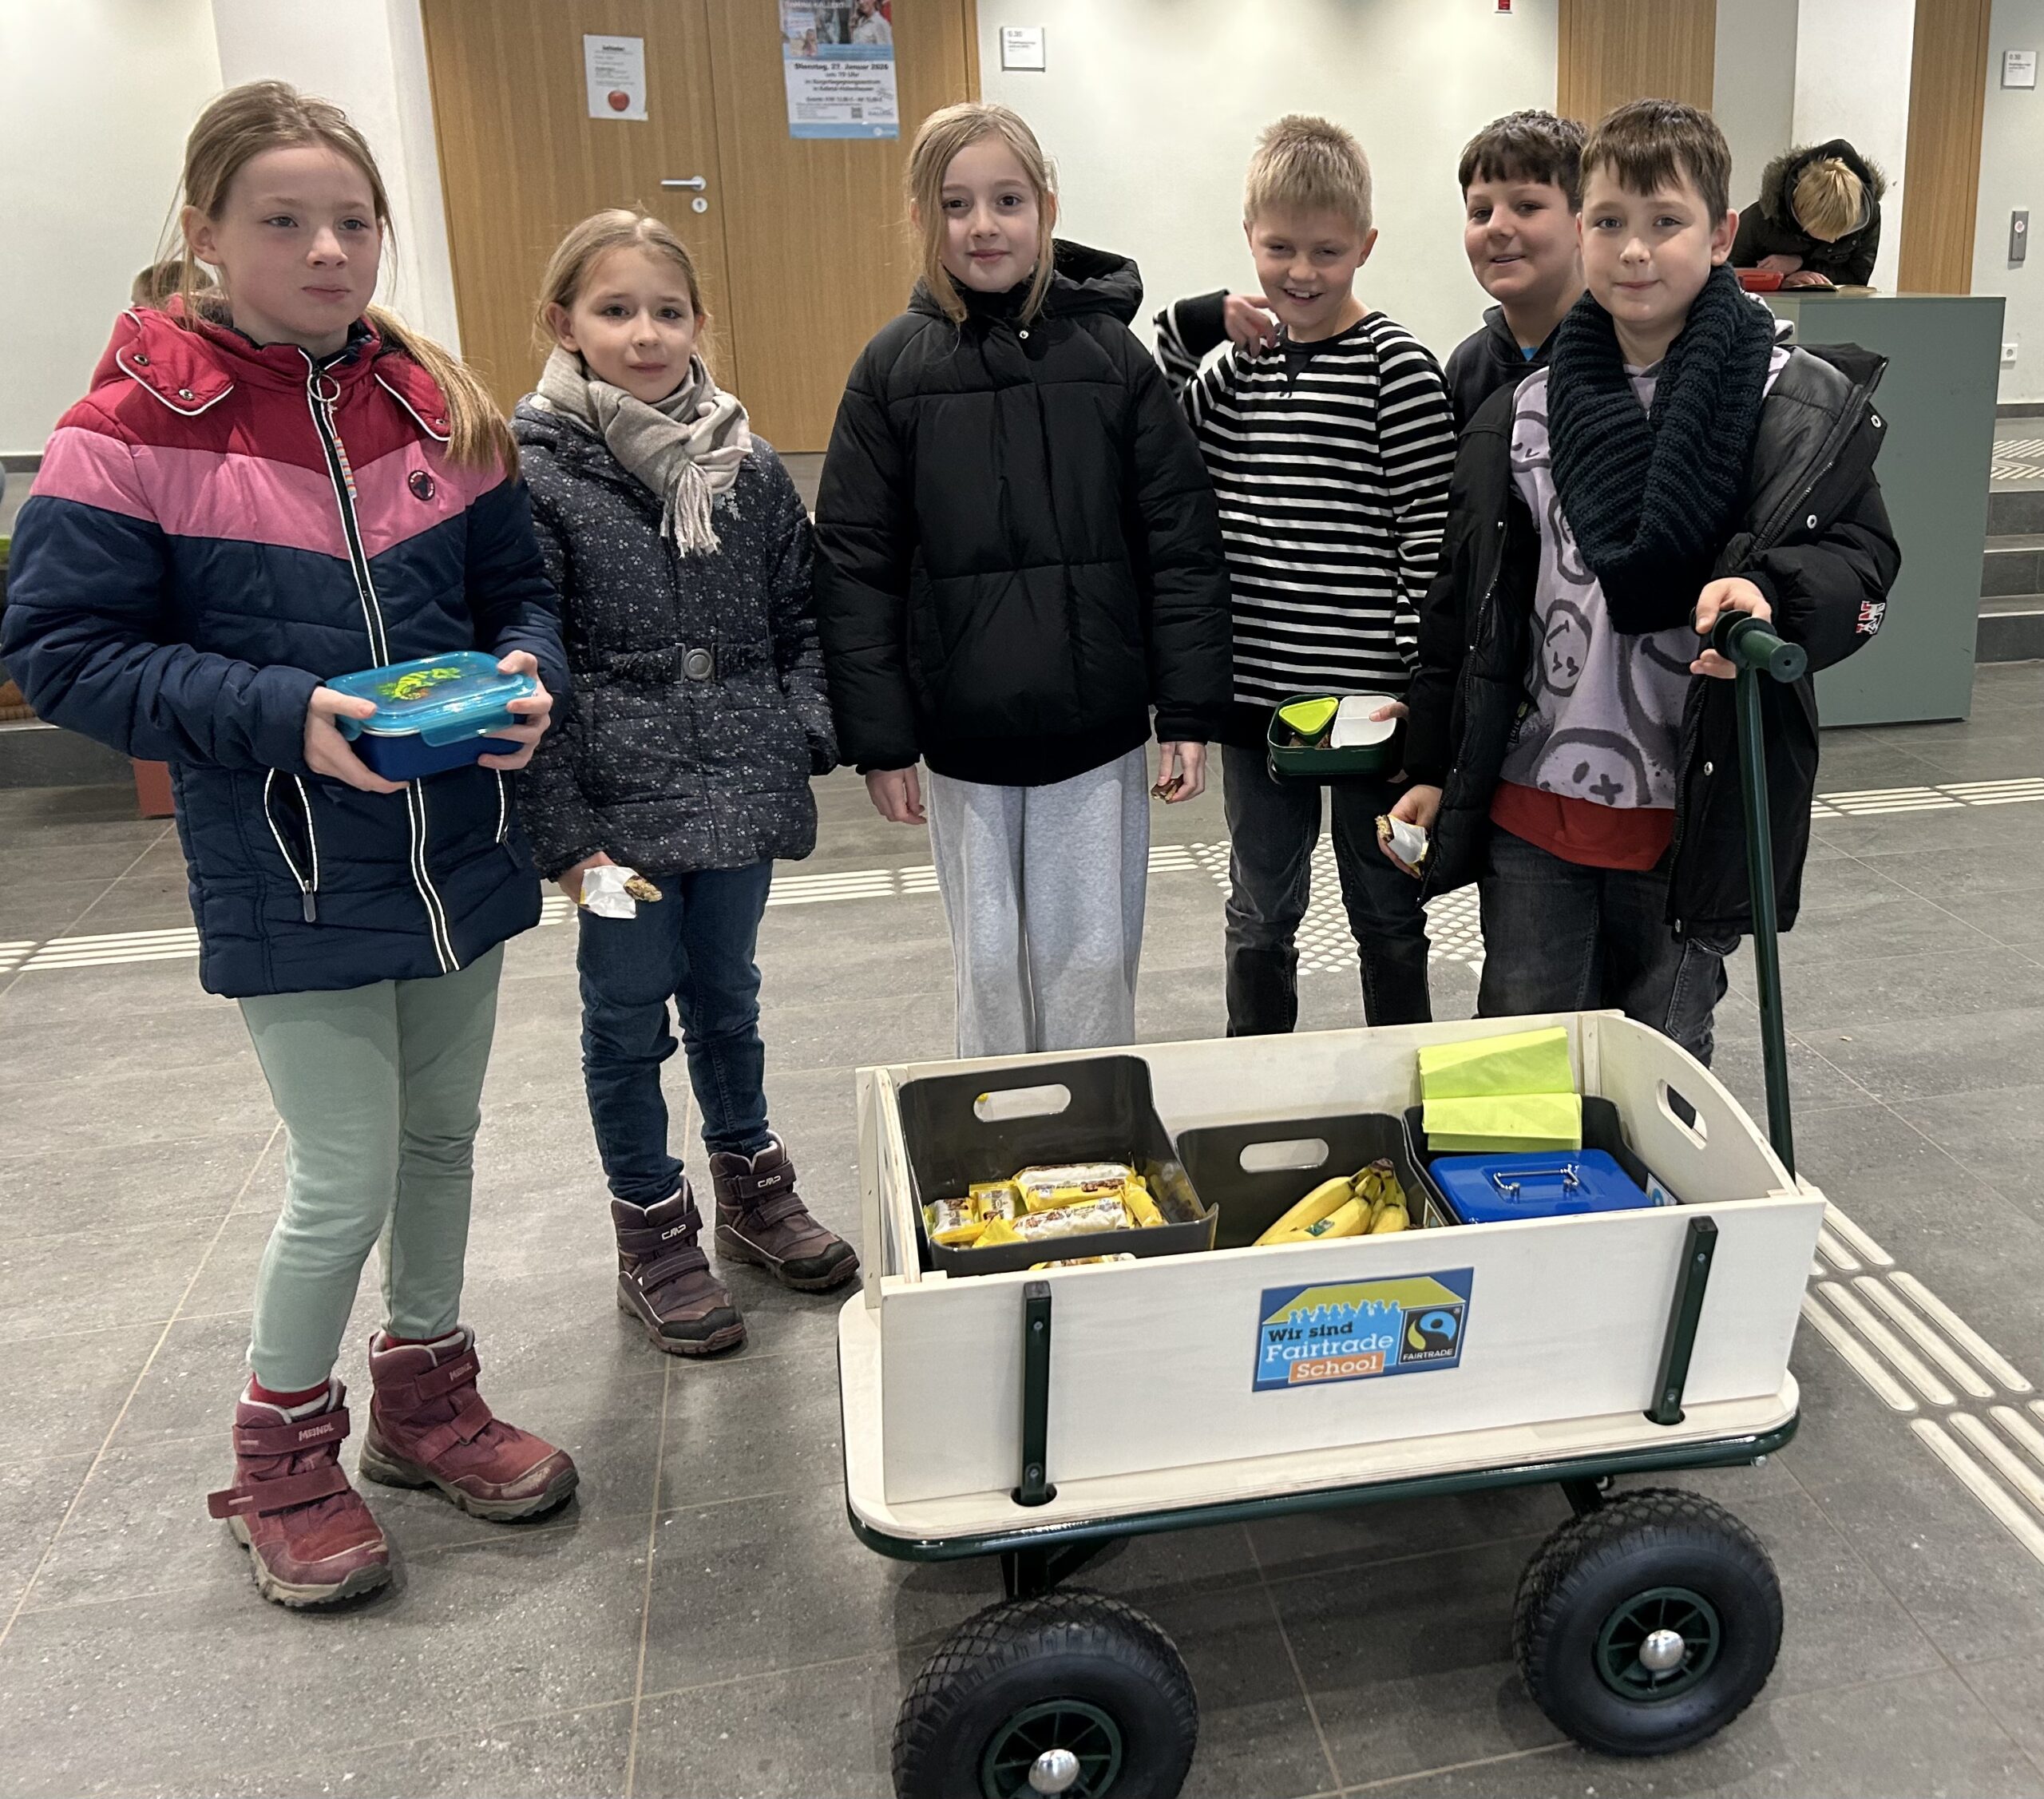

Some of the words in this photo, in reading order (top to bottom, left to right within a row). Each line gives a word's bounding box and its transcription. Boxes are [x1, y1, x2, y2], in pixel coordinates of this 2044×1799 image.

[794, 62, 830, 71] Dienstag,
[758, 1175, 782, 1188] CMP
[661, 1223, 687, 1240] CMP
[1268, 1327, 1302, 1342] Wir
[1308, 1321, 1353, 1339] sind
[1266, 1333, 1394, 1362] Fairtrade
[1403, 1348, 1453, 1361] FAIRTRADE
[1296, 1356, 1377, 1379] School
[299, 1422, 335, 1442] MEINDL
